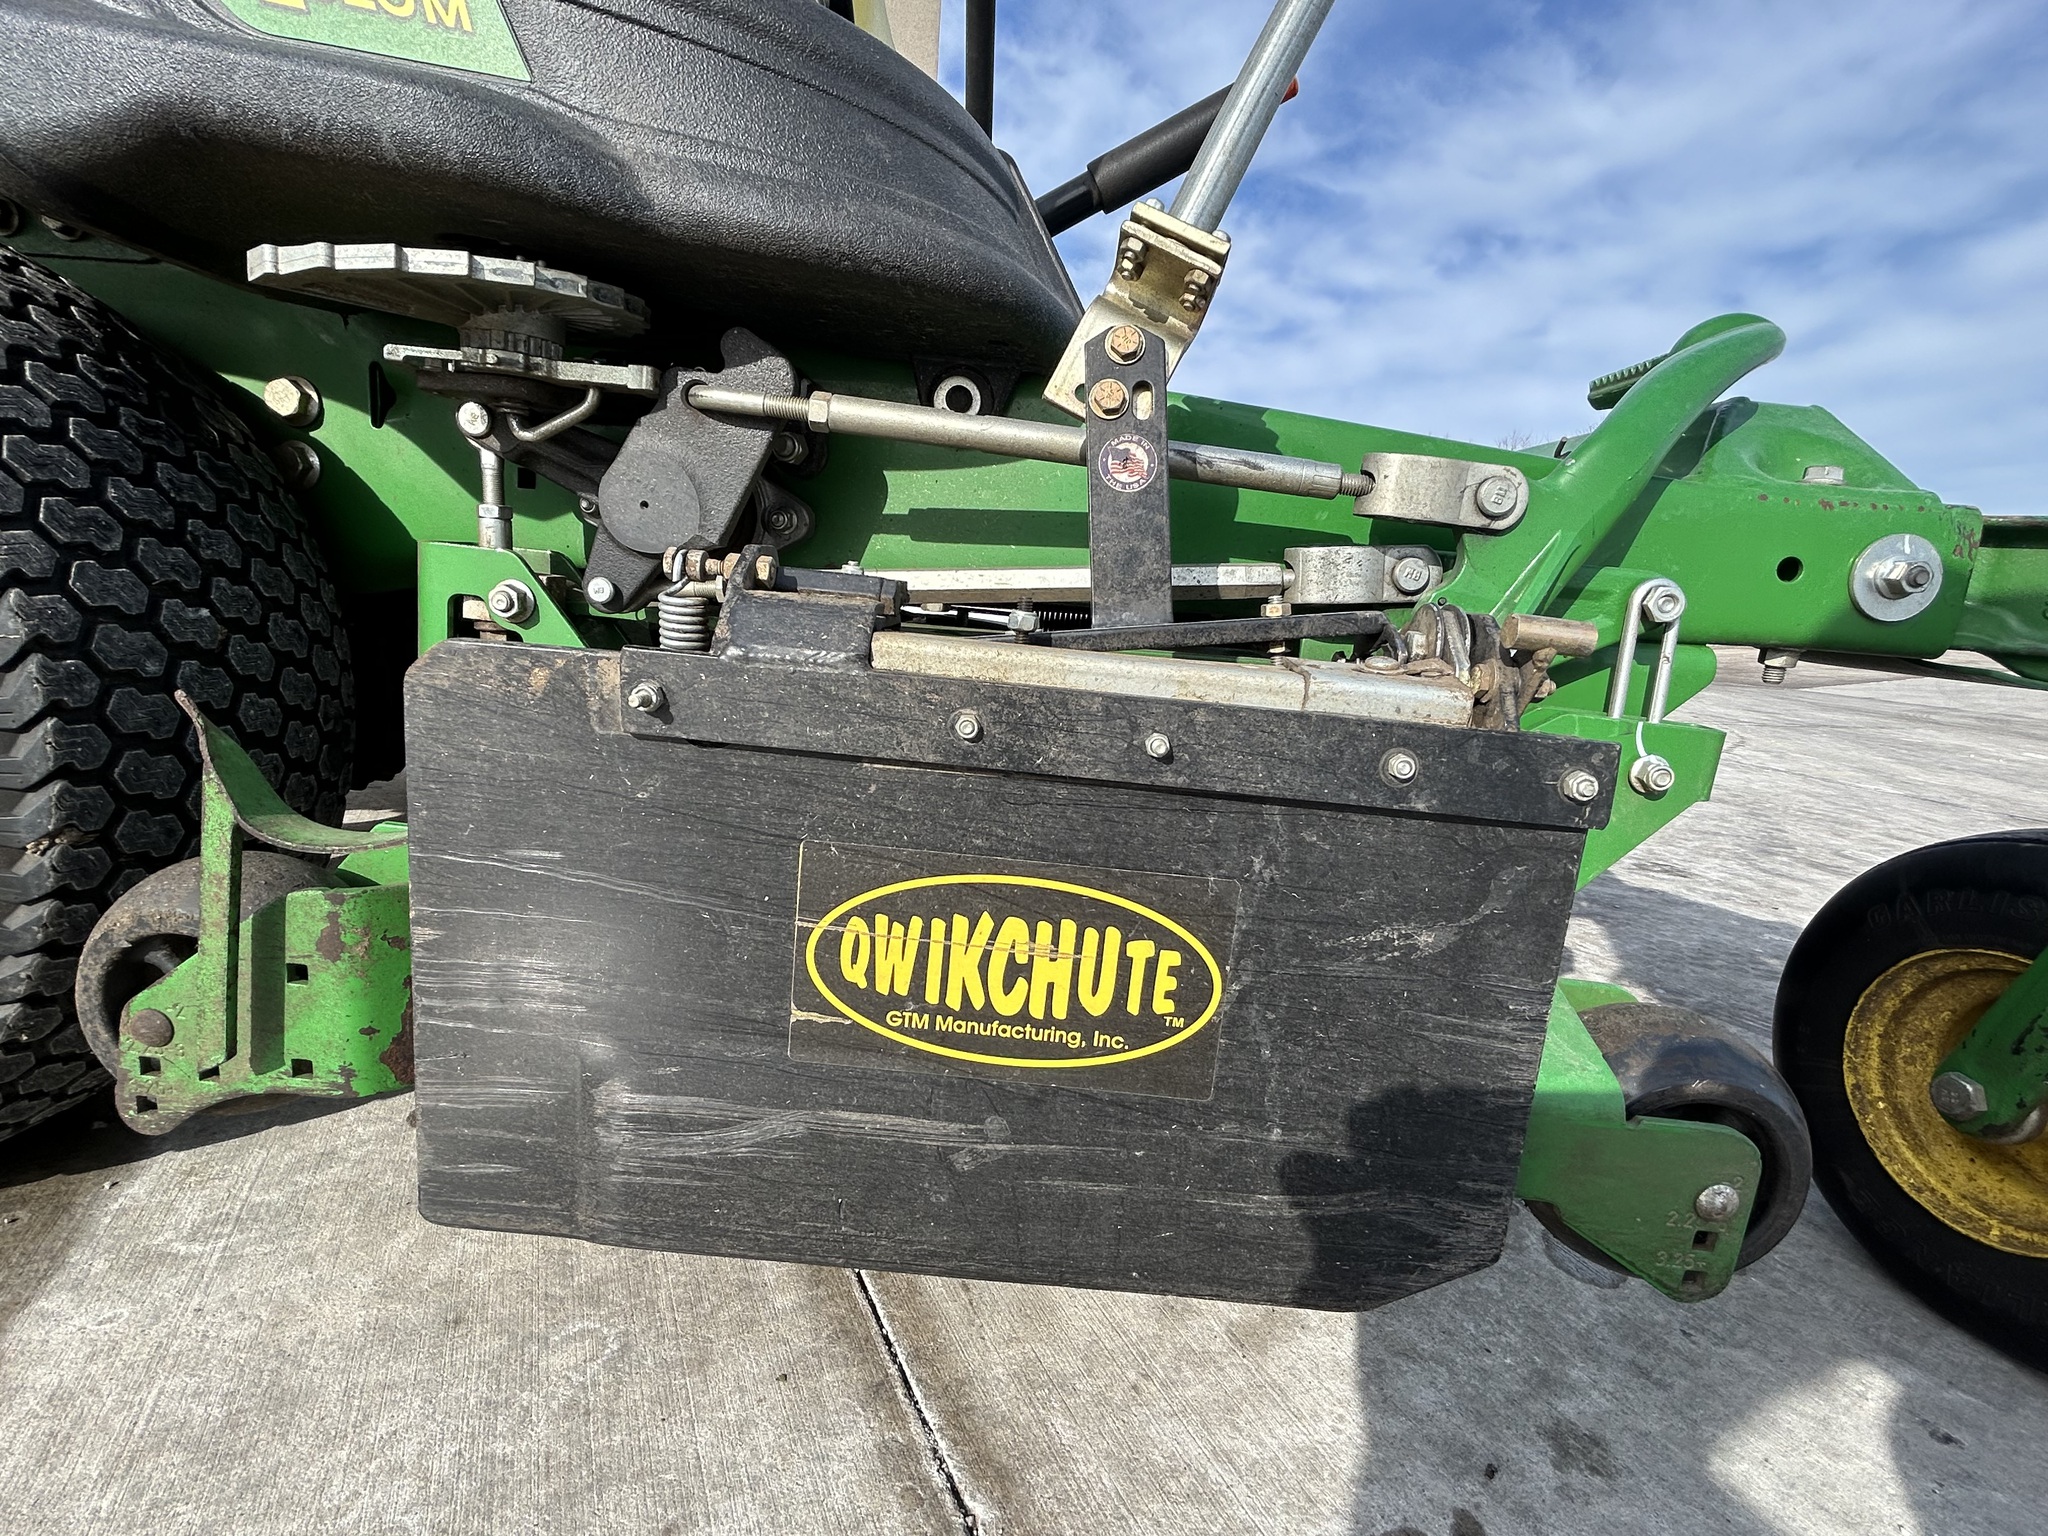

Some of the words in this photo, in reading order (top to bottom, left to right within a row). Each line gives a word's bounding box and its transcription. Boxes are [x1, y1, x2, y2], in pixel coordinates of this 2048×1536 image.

[1110, 435, 1138, 446] MADE
[1140, 440, 1150, 450] IN
[1106, 473, 1122, 490] THE
[1125, 479, 1146, 490] USA
[840, 911, 1181, 1020] QWIKCHUTE
[885, 1011, 929, 1030] GTM
[935, 1015, 1086, 1048] Manufacturing,
[1093, 1031, 1129, 1050] Inc.
